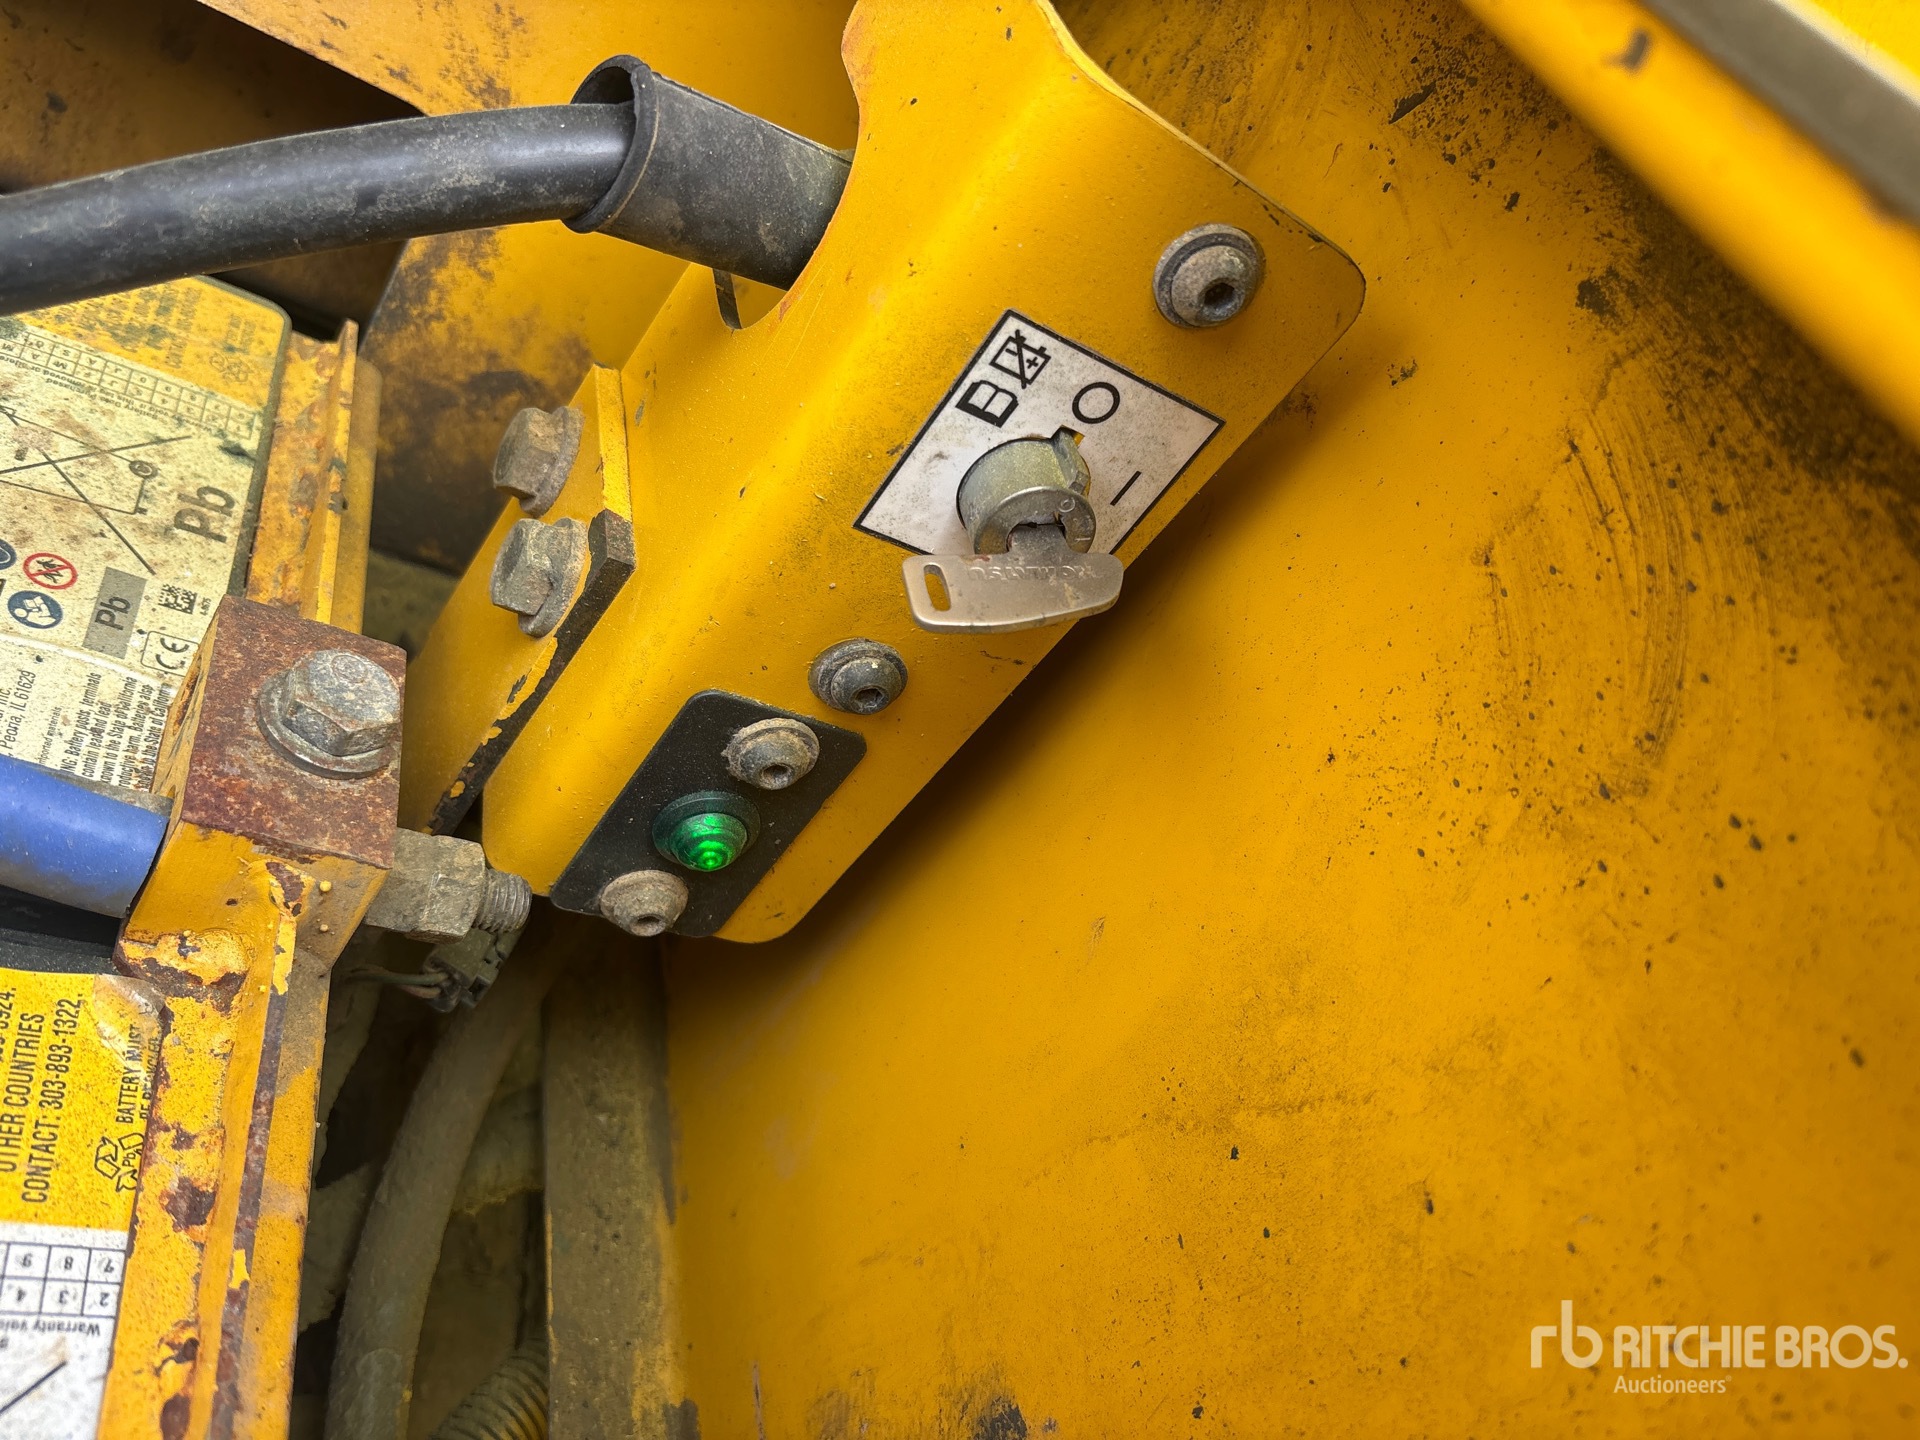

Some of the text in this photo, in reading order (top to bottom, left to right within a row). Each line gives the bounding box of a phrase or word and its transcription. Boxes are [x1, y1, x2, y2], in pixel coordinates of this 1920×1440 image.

[173, 485, 236, 543] Pb
[94, 595, 132, 631] Pb
[0, 715, 26, 750] Peoria,
[14, 669, 37, 701] 61629
[38, 736, 54, 764] mported
[64, 728, 86, 757] Battery
[81, 750, 100, 778] contain
[116, 754, 136, 788] roductive
[4, 1012, 46, 1108] COUNTRIES
[21, 993, 84, 1204] CONTACT: 303-893-1322.
[115, 1067, 141, 1124] BATTERY
[33, 1319, 101, 1336] Warranty
